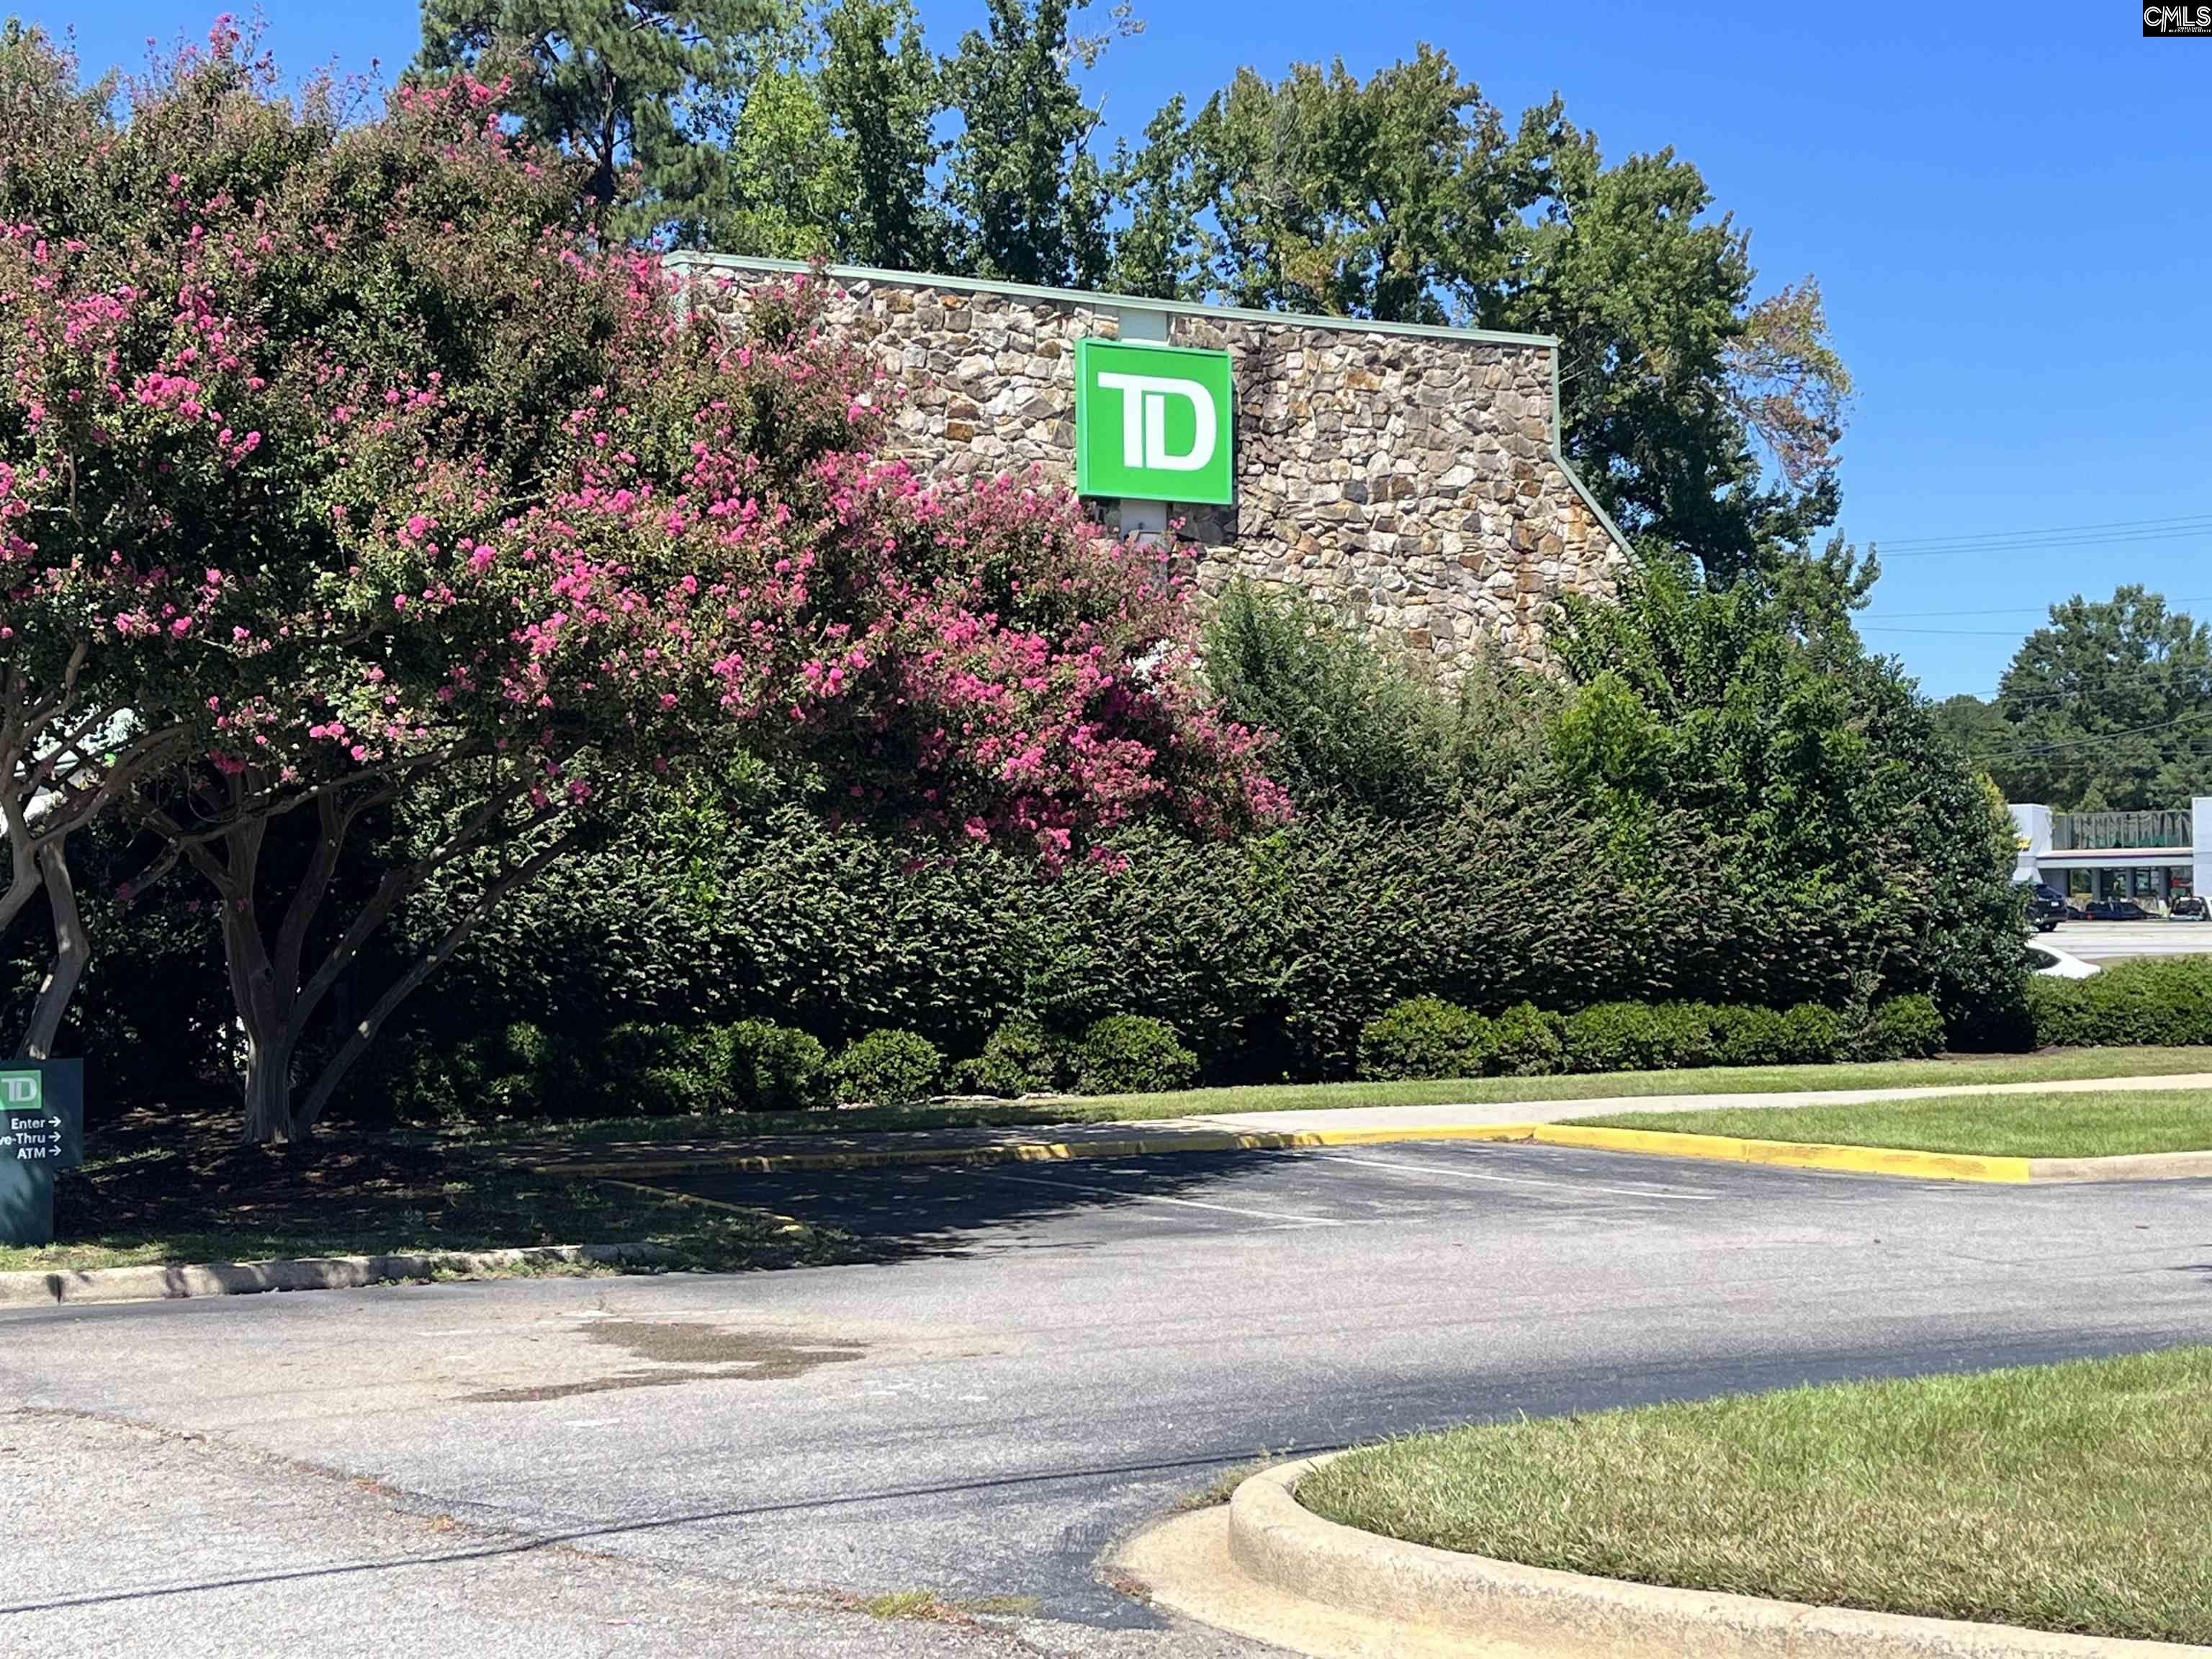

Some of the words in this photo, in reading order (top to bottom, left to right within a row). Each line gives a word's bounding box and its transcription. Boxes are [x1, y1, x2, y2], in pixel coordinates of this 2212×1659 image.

[1097, 372, 1217, 471] TD
[1, 1077, 37, 1102] TD
[11, 1118, 45, 1130] Enter
[17, 1147, 46, 1159] ATM
